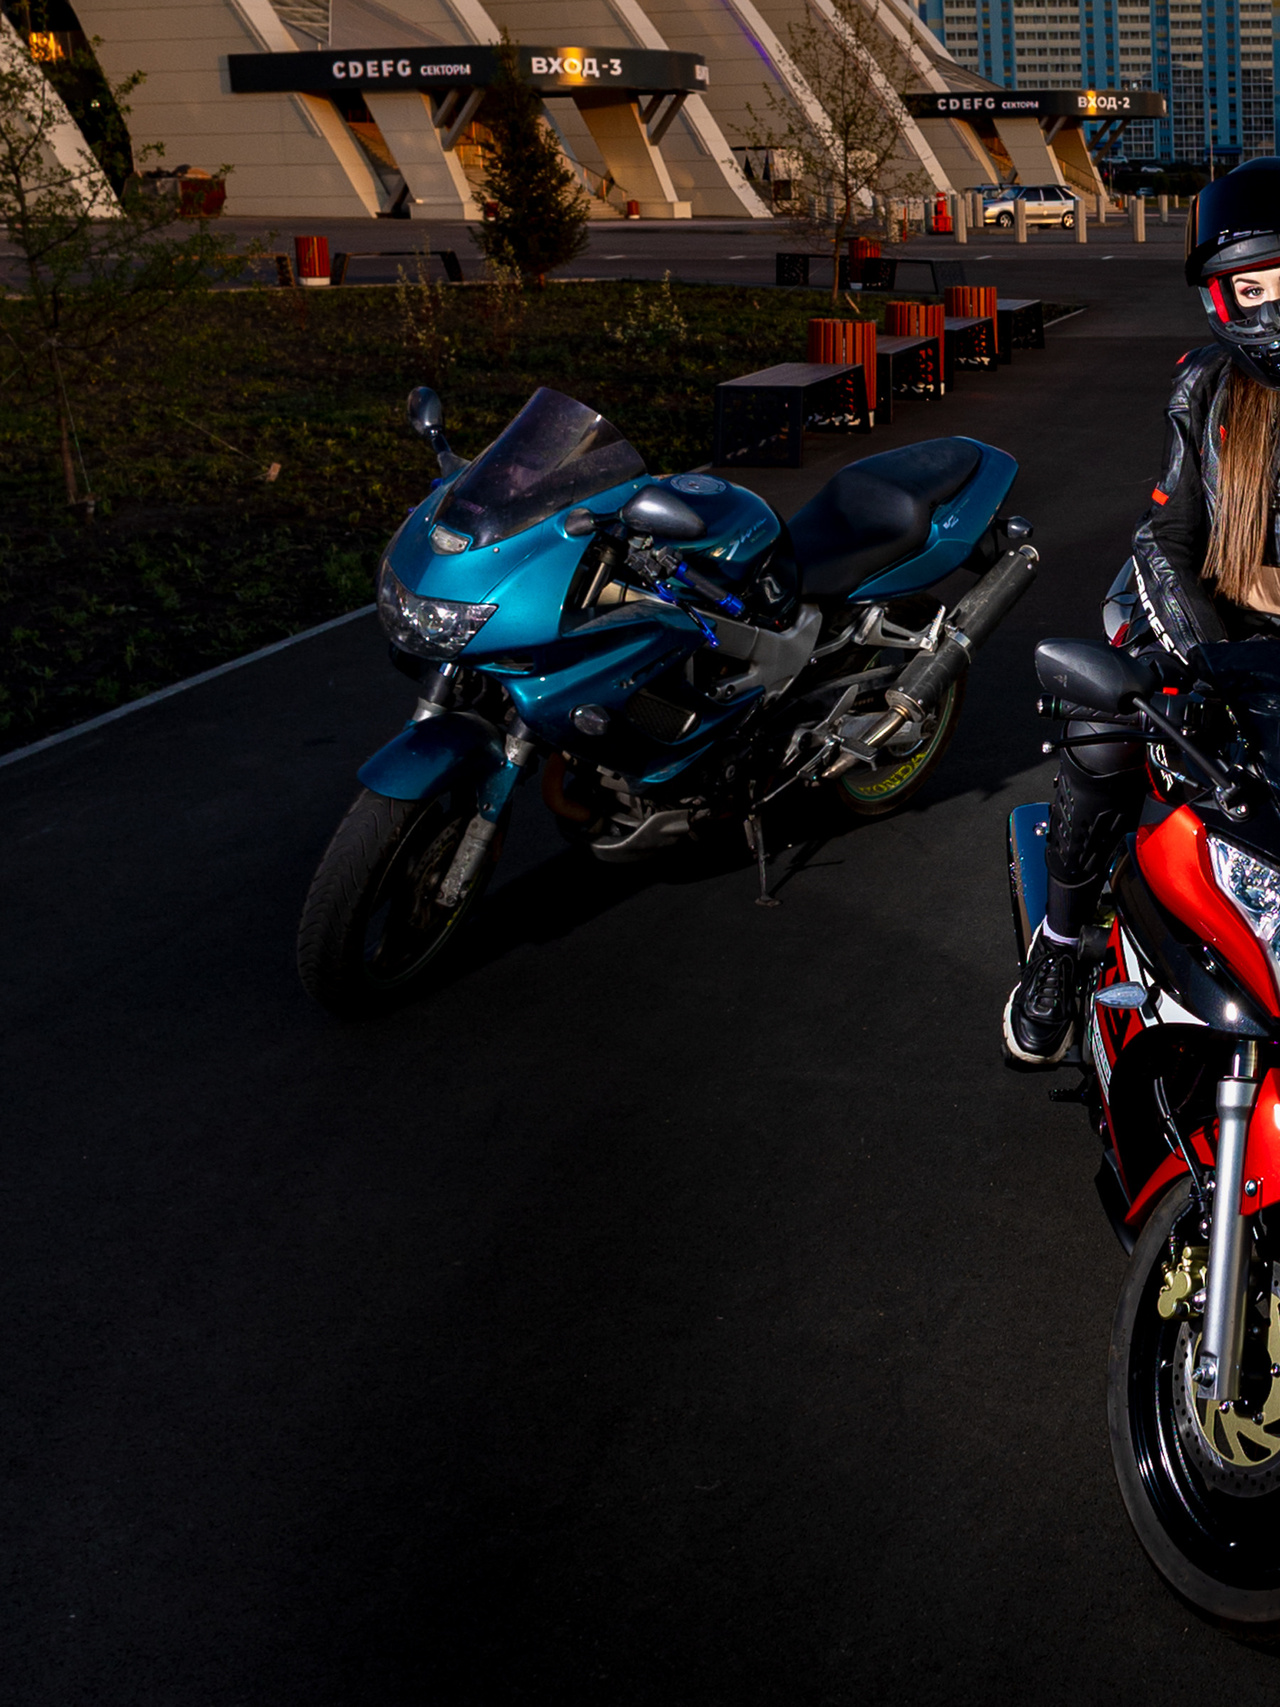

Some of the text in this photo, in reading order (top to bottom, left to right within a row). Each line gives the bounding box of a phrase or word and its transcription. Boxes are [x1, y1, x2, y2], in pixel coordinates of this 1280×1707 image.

[331, 58, 472, 80] CDEFG СЕКТОРЫ
[530, 56, 623, 79] ВХОД-3
[936, 97, 1040, 111] CDEFG СЕКТОРЫ
[1077, 96, 1131, 110] ВХОД-2
